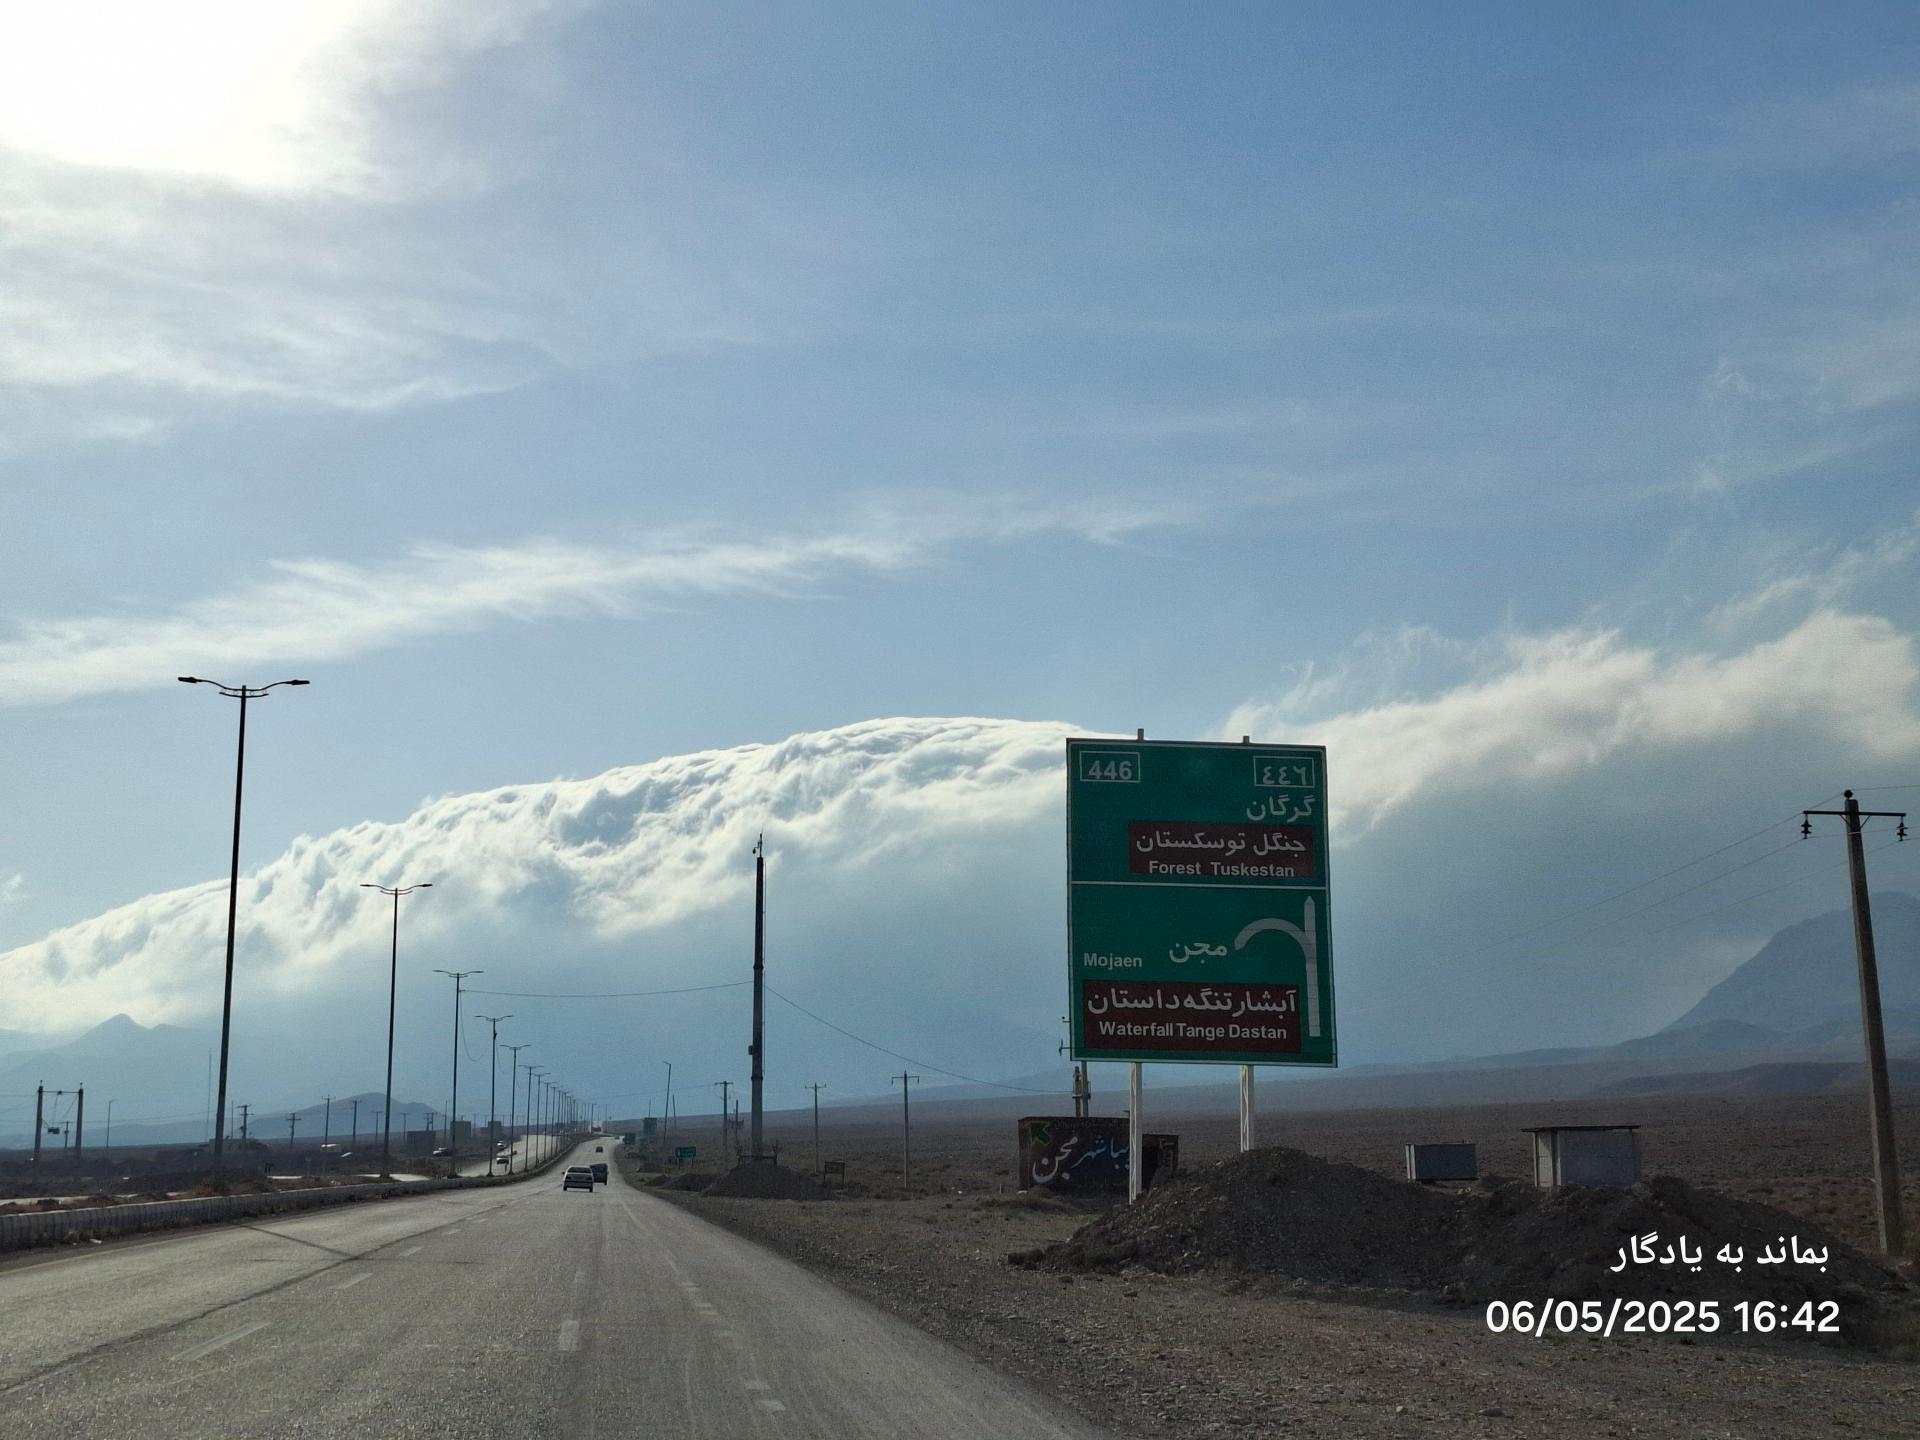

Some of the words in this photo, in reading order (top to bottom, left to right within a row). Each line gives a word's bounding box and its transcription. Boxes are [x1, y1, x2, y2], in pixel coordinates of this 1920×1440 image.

[1088, 760, 1132, 780] 446
[1246, 794, 1316, 823] گرگان
[1136, 831, 1246, 856] توسکستان
[1252, 832, 1307, 857] جنگل
[1149, 860, 1201, 875] Forest
[1210, 862, 1295, 878] Tuskestan
[1083, 952, 1143, 970] Mojaen
[1169, 941, 1228, 964] مجن
[1099, 1020, 1173, 1037] Waterfall
[1176, 1022, 1226, 1041] Tange
[1229, 1024, 1287, 1040] Dastan
[1032, 1136, 1079, 1183] مجن
